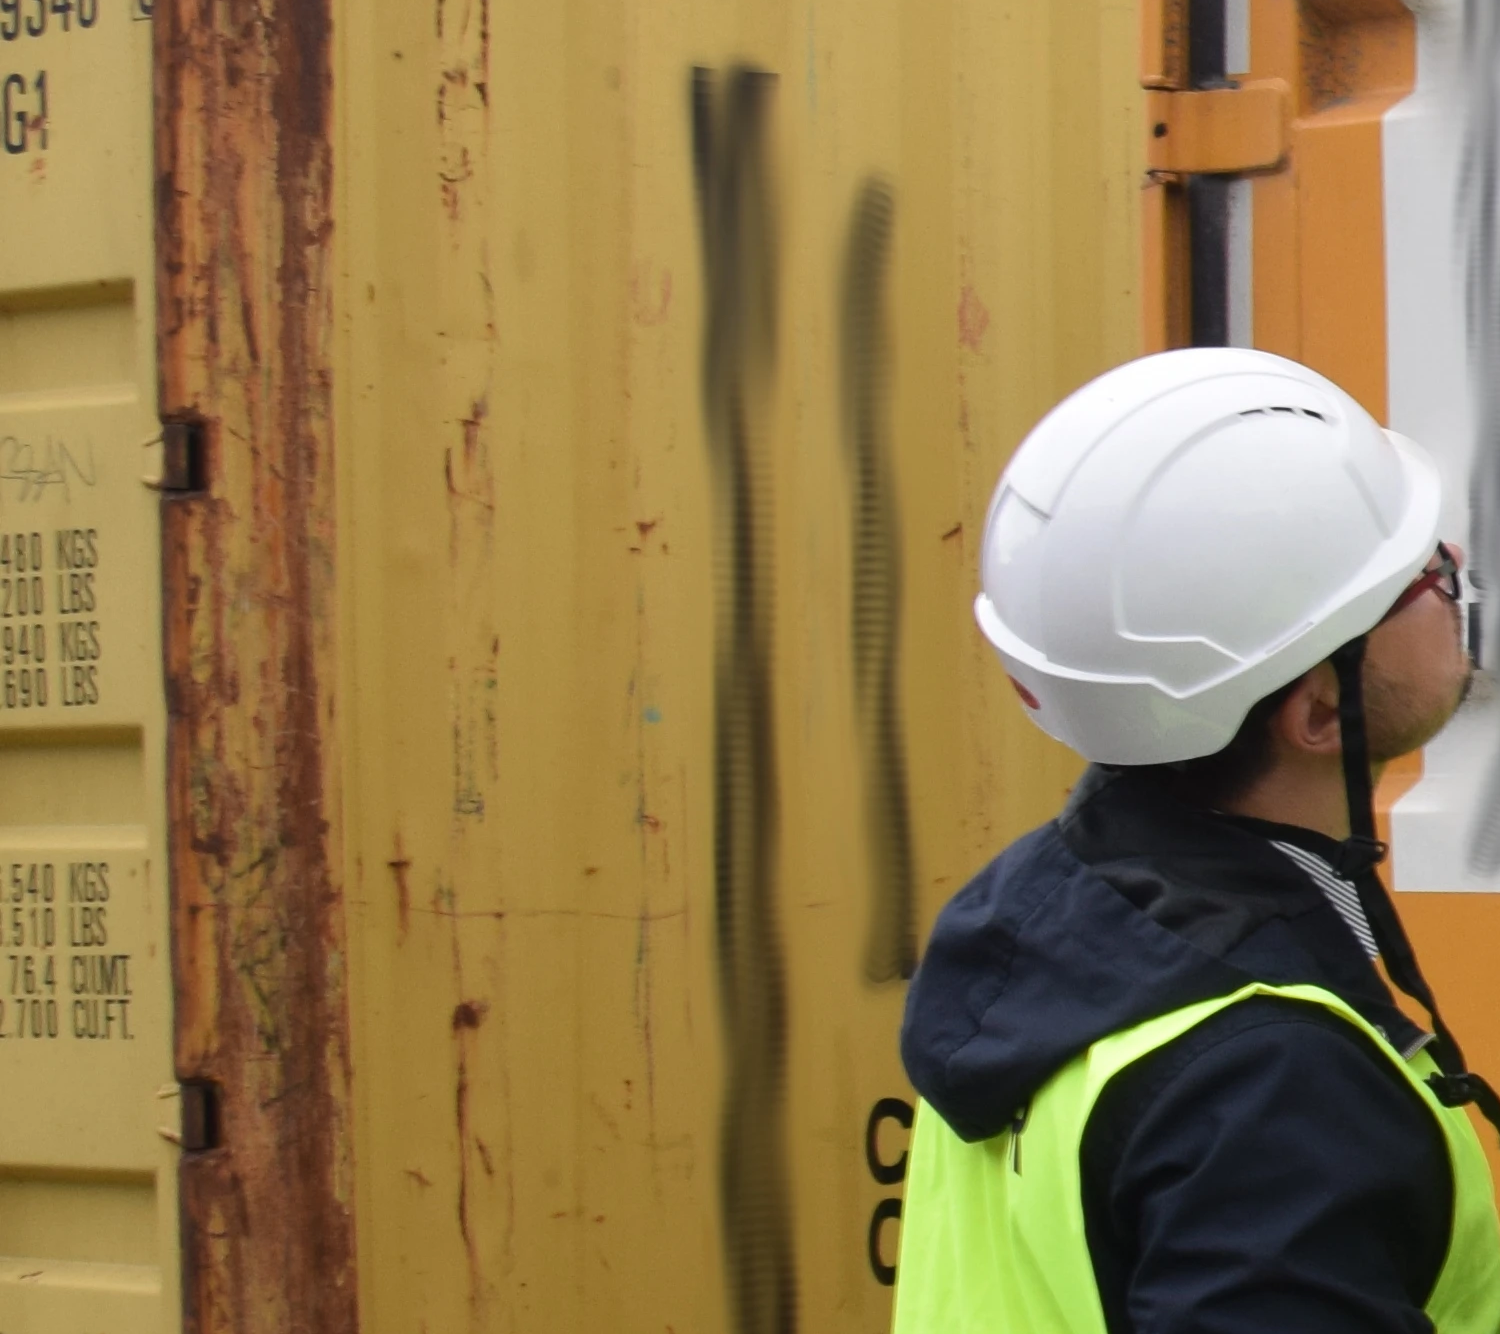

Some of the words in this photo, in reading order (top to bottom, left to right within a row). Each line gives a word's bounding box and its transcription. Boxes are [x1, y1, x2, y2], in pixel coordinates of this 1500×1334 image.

[3, 70, 49, 155] G1
[57, 528, 99, 570] KGS
[59, 572, 96, 614] LBS
[59, 620, 101, 663] KGS
[60, 665, 99, 706] LBS
[68, 862, 109, 903] KGS
[69, 906, 107, 947] LBS
